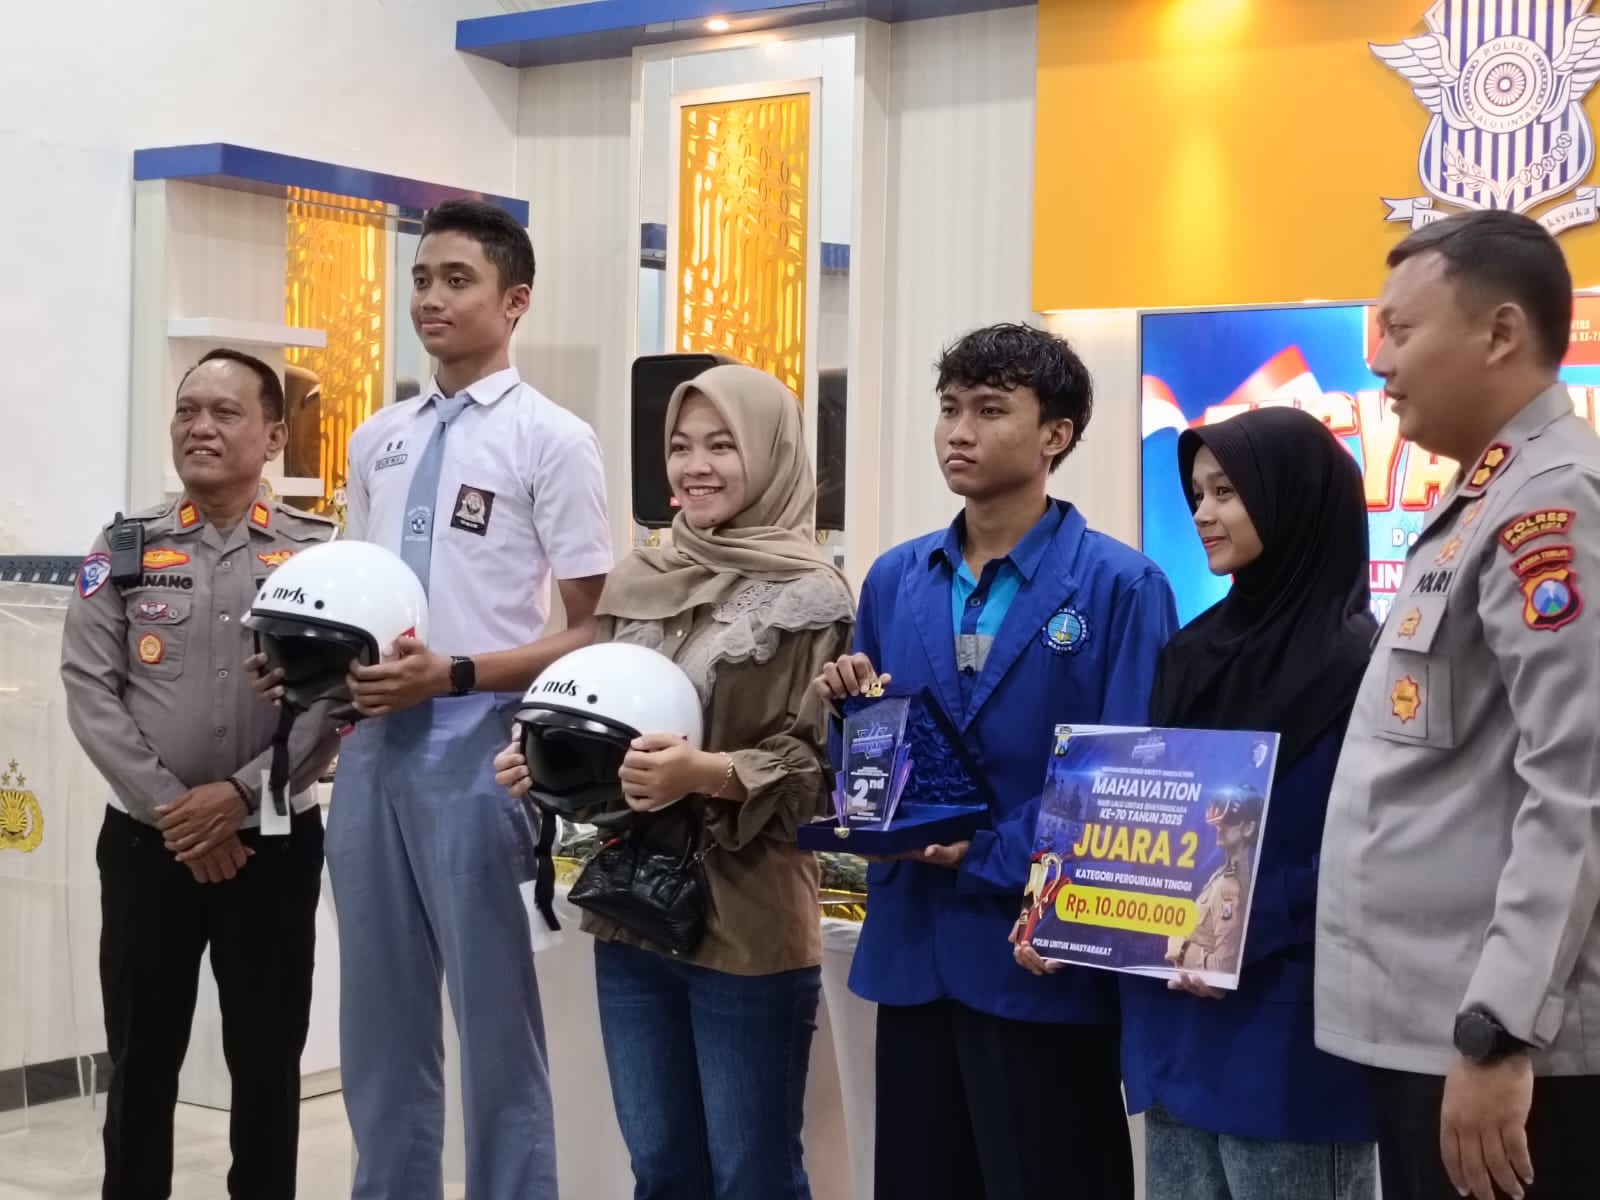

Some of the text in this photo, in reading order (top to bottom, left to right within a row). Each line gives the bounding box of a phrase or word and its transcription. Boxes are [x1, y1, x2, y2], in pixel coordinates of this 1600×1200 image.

[1483, 40, 1529, 56] POLISI
[1500, 105, 1538, 129] LINTAS
[1503, 512, 1569, 541] POLRES
[273, 587, 308, 604] mds
[542, 680, 580, 696] mds
[1092, 776, 1203, 802] MAHAVATION
[1099, 807, 1184, 826] KE-70 TAHUN 2025
[1073, 823, 1199, 869] JUARA 2
[1075, 868, 1193, 892] KATEGORI PERGURUAN TINGGI
[1065, 893, 1186, 927] Rp. 10.000.000
[1049, 940, 1069, 951] UNTUK
[1069, 943, 1113, 957] MASYARAKAT
